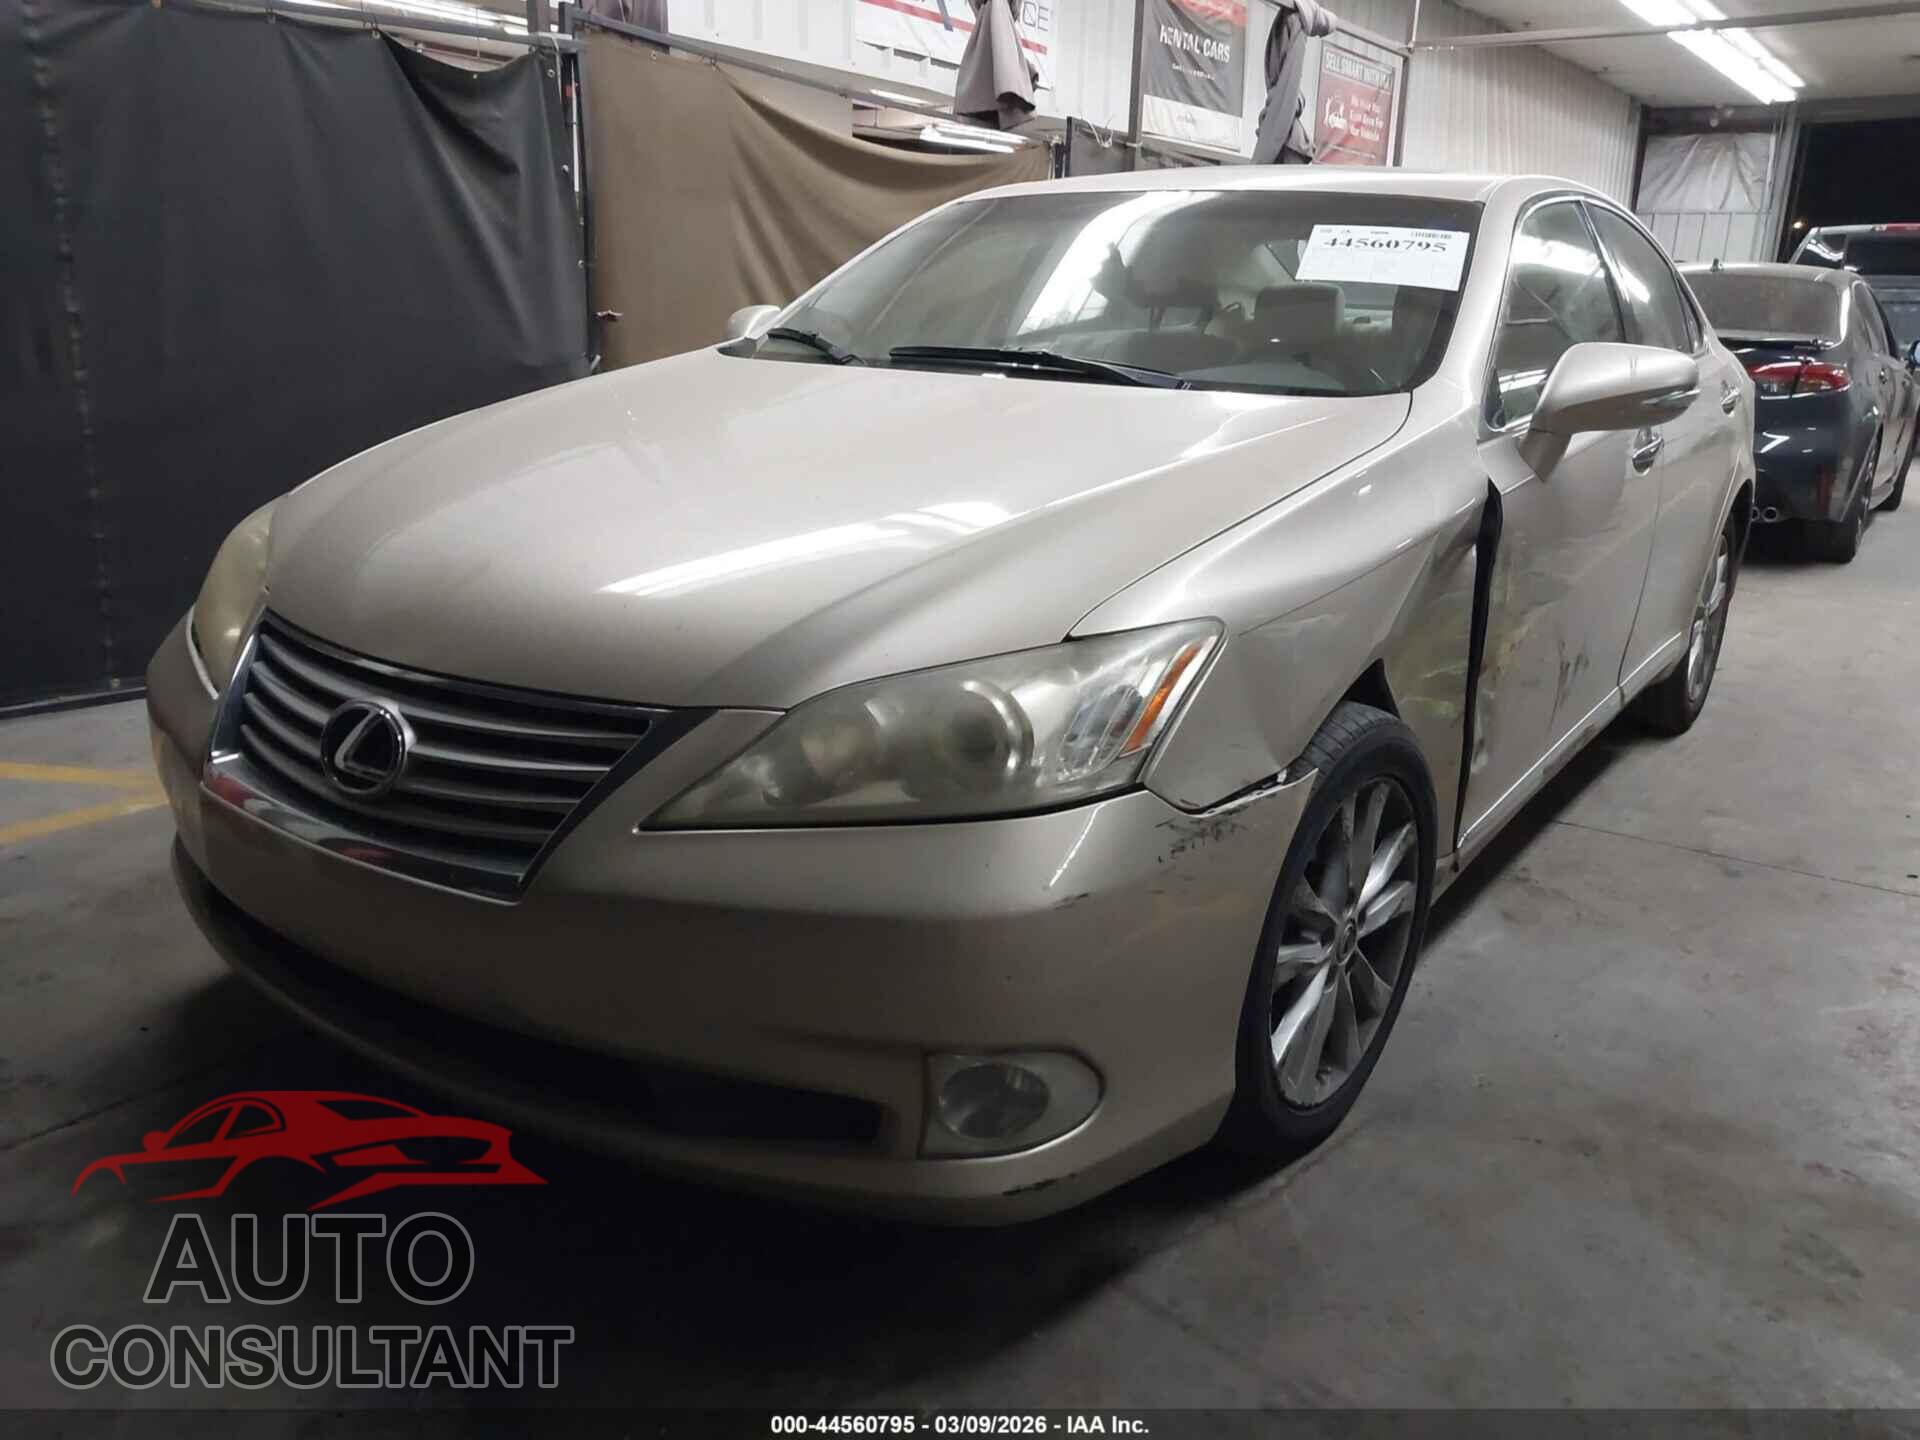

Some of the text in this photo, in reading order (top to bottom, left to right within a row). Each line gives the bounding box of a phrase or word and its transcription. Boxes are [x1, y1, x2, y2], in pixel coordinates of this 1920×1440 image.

[1159, 24, 1231, 64] RENTAL CARS
[1322, 237, 1448, 252] 44560795
